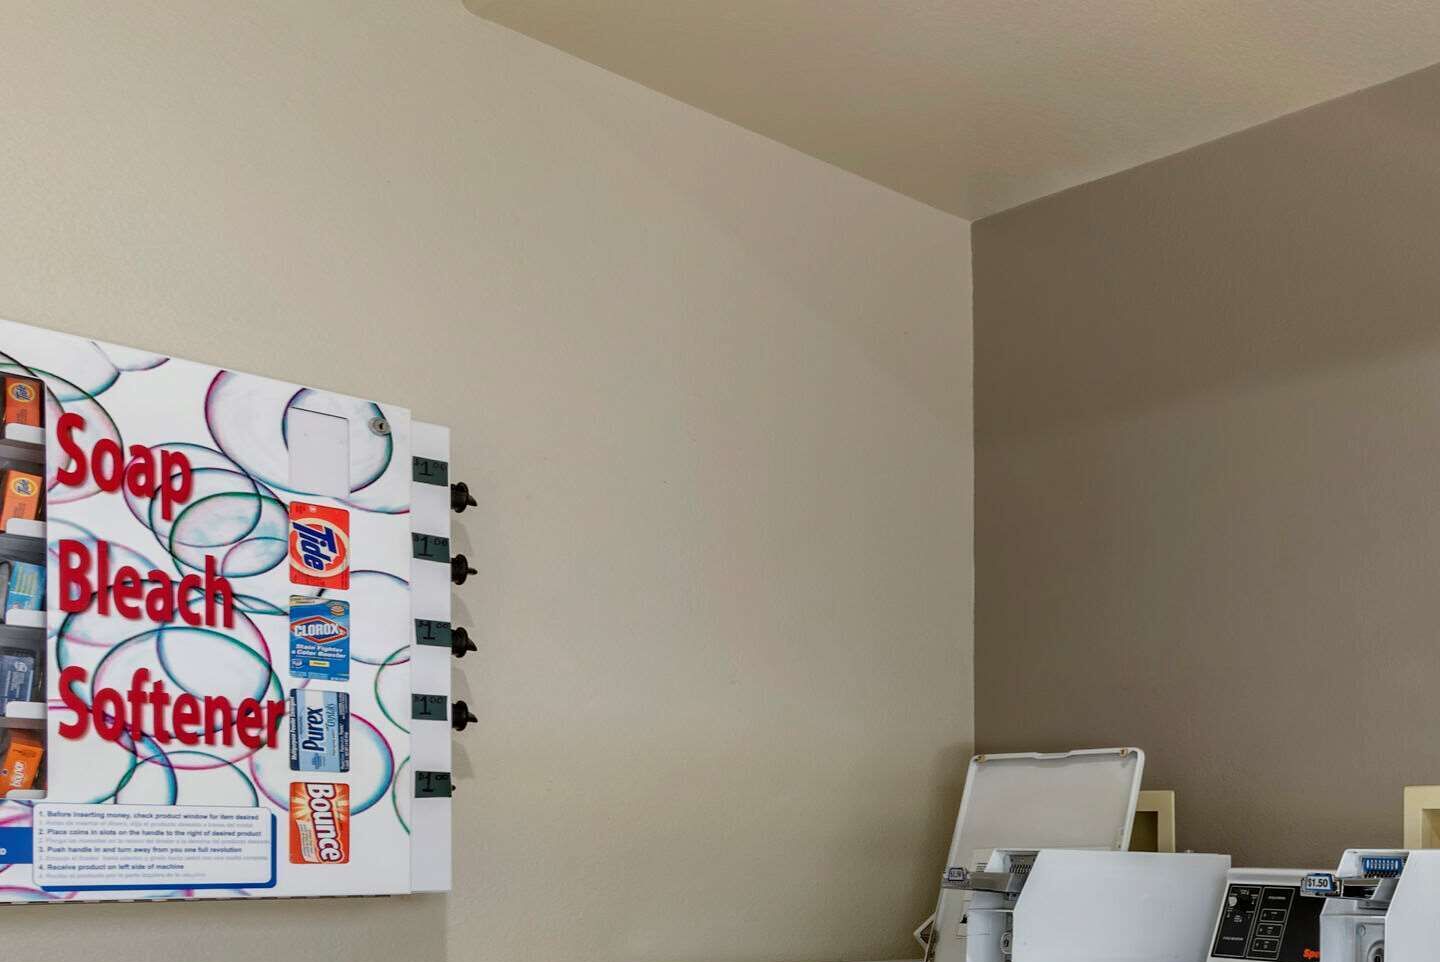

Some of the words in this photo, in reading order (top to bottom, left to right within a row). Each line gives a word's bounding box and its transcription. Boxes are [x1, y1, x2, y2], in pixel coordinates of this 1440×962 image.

[56, 412, 193, 521] Soap
[292, 522, 337, 571] Tide
[58, 539, 235, 629] Bleach
[295, 623, 339, 638] CLOROX
[58, 666, 286, 749] Softener
[302, 707, 325, 752] Purex
[73, 811, 104, 819] inserting
[305, 783, 343, 862] Bounce
[1308, 878, 1328, 888] $1.50
